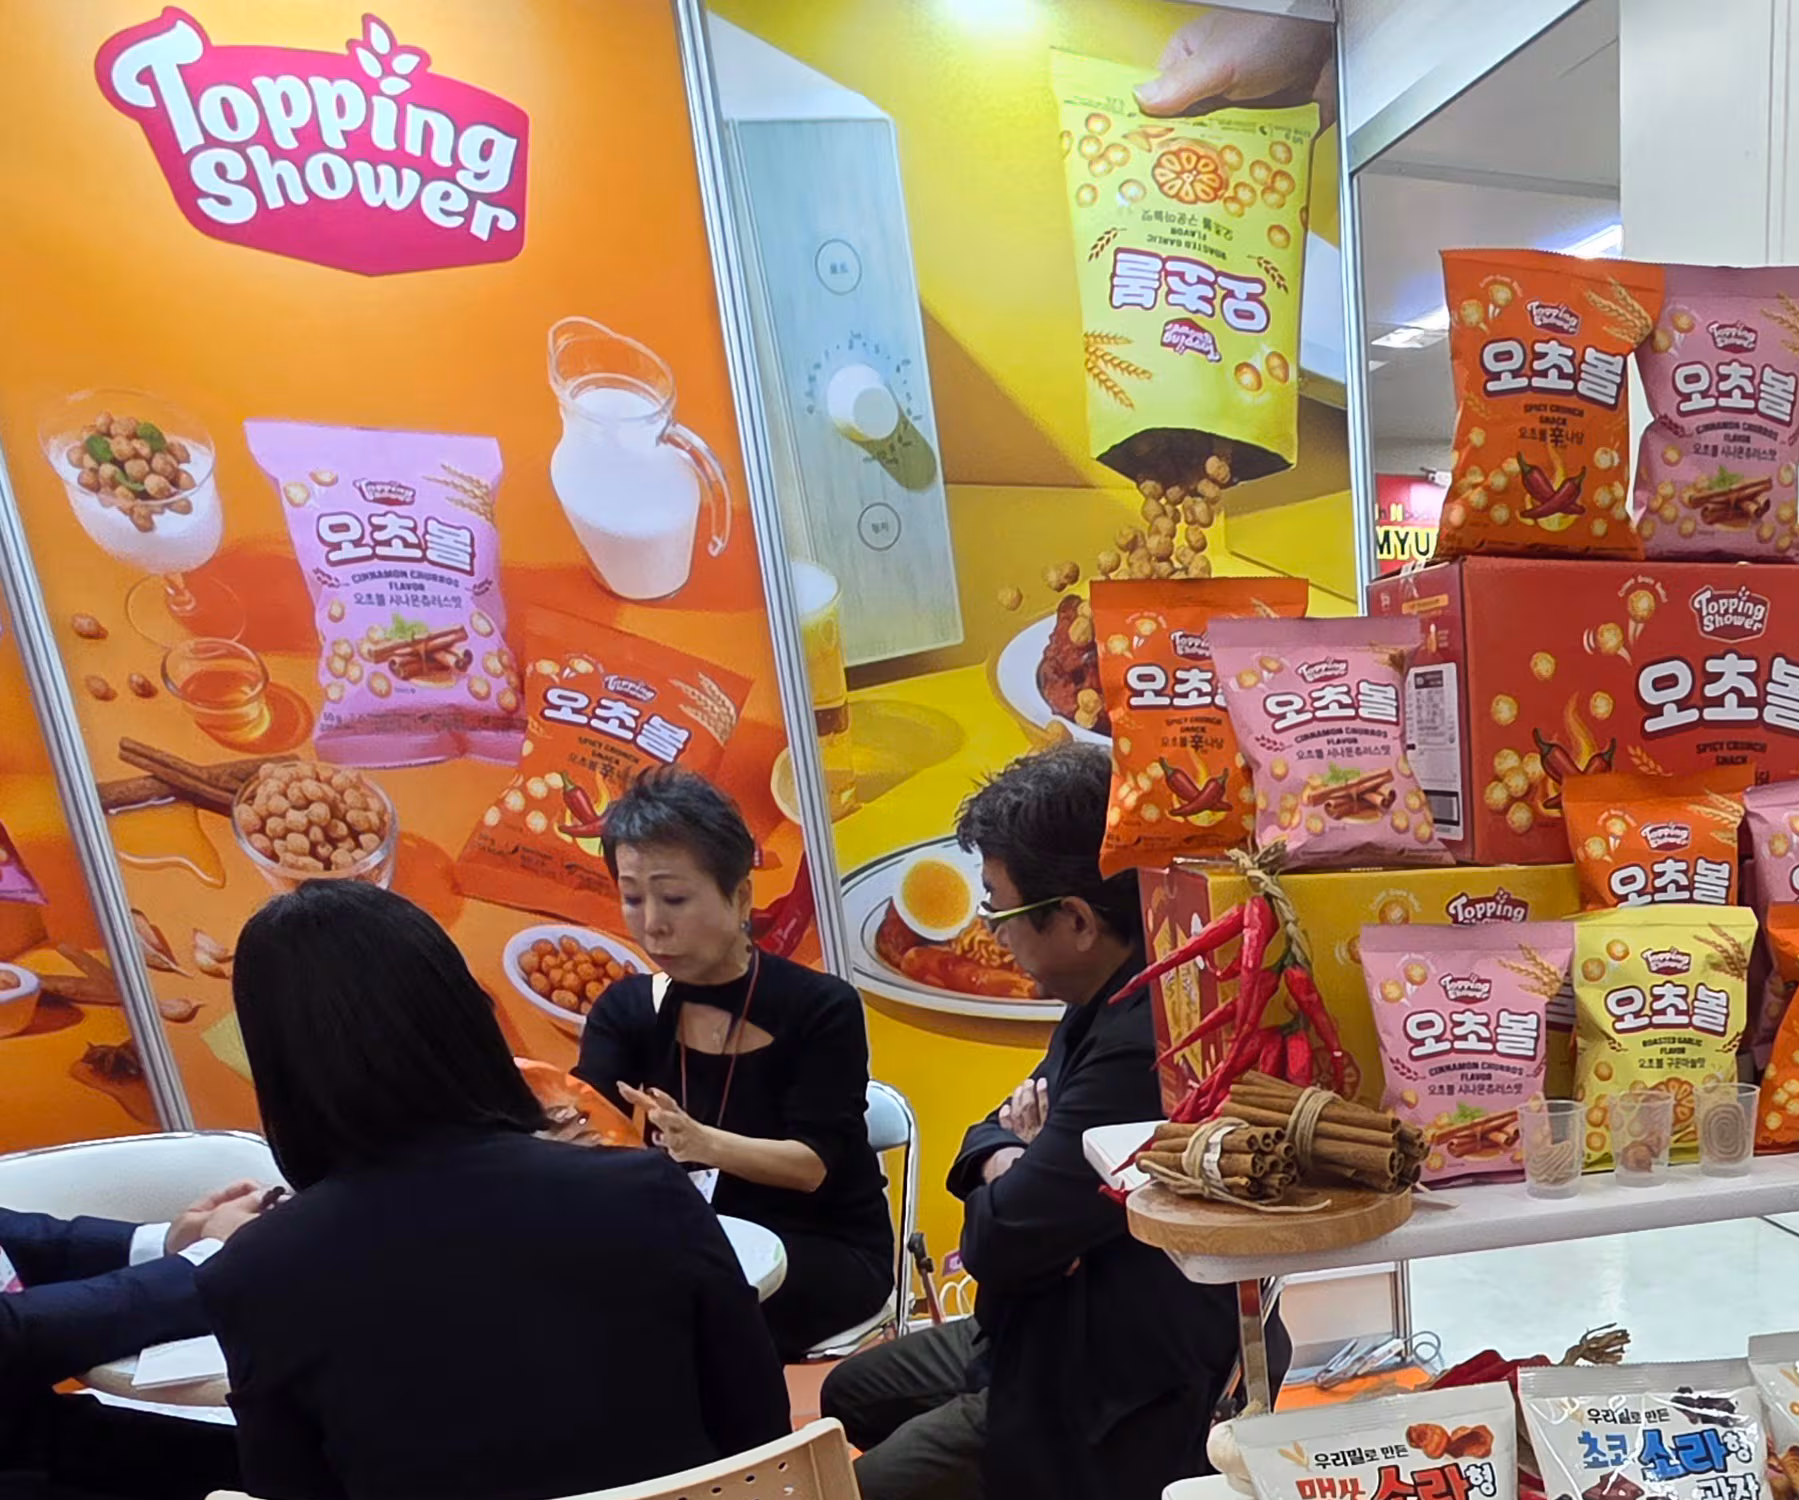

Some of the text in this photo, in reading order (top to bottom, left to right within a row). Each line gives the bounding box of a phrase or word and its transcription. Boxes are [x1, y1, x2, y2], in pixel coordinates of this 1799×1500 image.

[111, 19, 518, 194] Topping
[189, 147, 518, 242] Shower
[1110, 249, 1270, 331] 오초볼
[1481, 338, 1626, 406] 오초볼
[1673, 359, 1798, 424] 오초볼
[317, 510, 475, 575] 오초볼
[1694, 589, 1766, 620] Topping
[1703, 614, 1763, 632] Shower
[1126, 664, 1227, 707] 오초
[1264, 681, 1399, 730] 오초볼
[543, 687, 690, 764] 오초볼
[1609, 858, 1731, 907] 오초볼
[1448, 895, 1526, 923] Topping
[1605, 982, 1729, 1033] 오초볼
[1405, 1010, 1539, 1058] 오초볼
[1644, 1407, 1671, 1423] 만든
[1313, 1444, 1410, 1469] 우리밀로 만든
[1577, 1430, 1630, 1470] 초코
